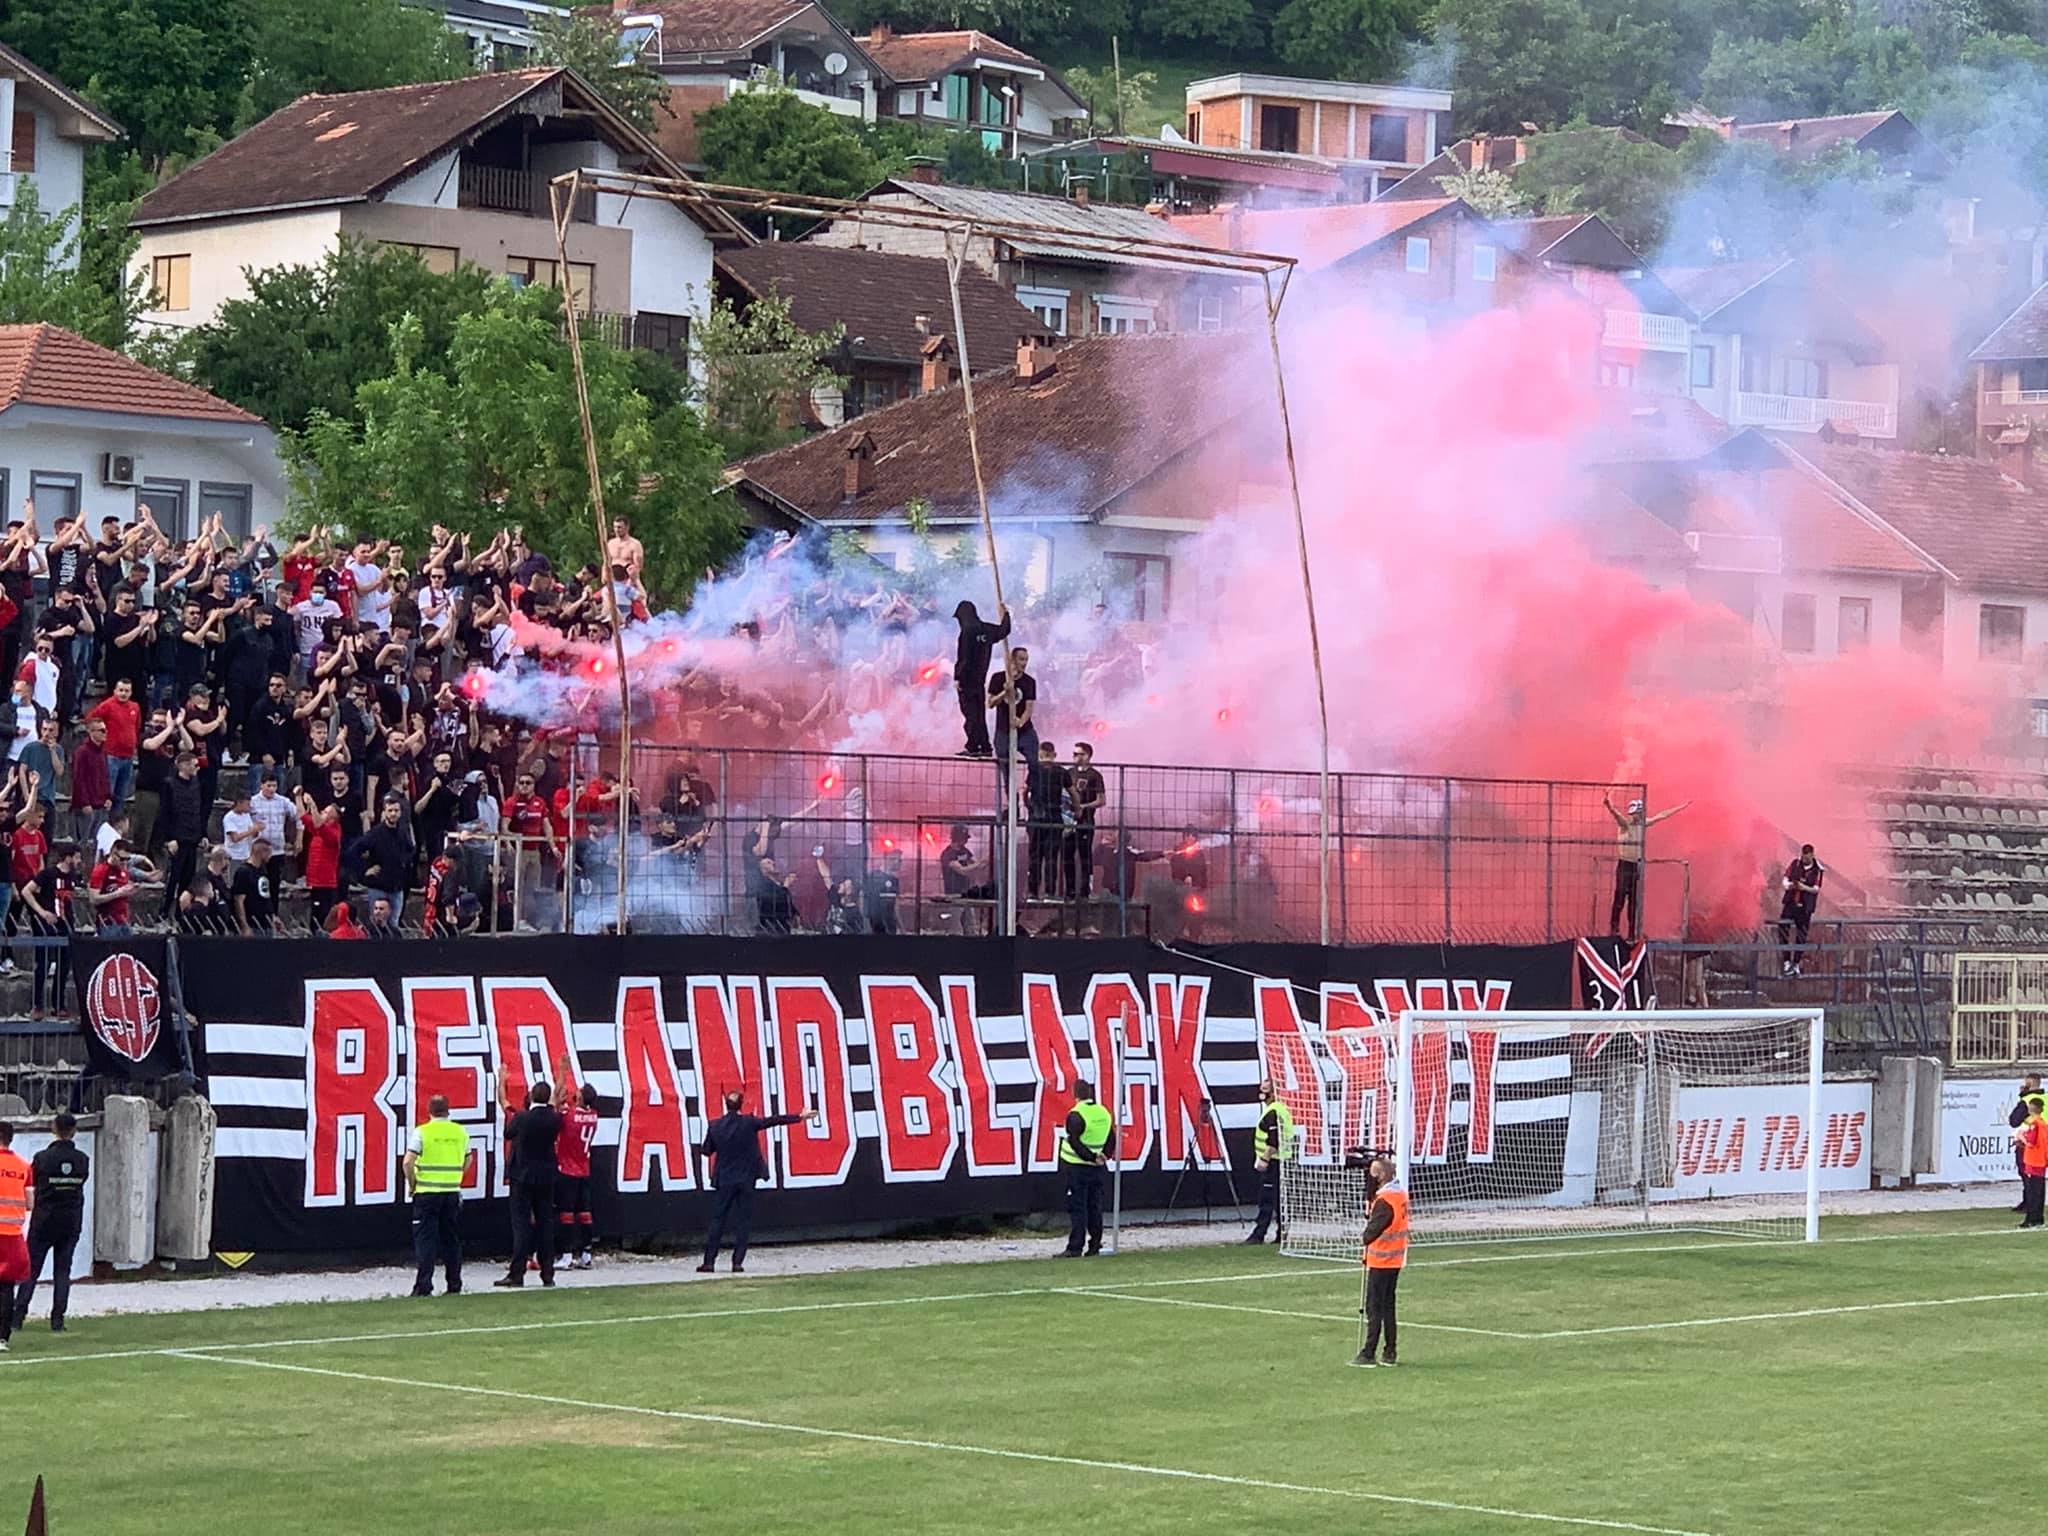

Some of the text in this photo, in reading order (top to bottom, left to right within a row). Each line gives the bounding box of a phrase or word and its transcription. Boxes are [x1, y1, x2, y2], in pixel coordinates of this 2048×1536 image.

[303, 976, 585, 1208] RED
[616, 974, 857, 1192] AND
[860, 972, 1232, 1184] BLACK
[1253, 977, 1513, 1166] ARMY
[580, 1125, 594, 1154] 4
[1958, 1134, 2004, 1158] NOBEL
